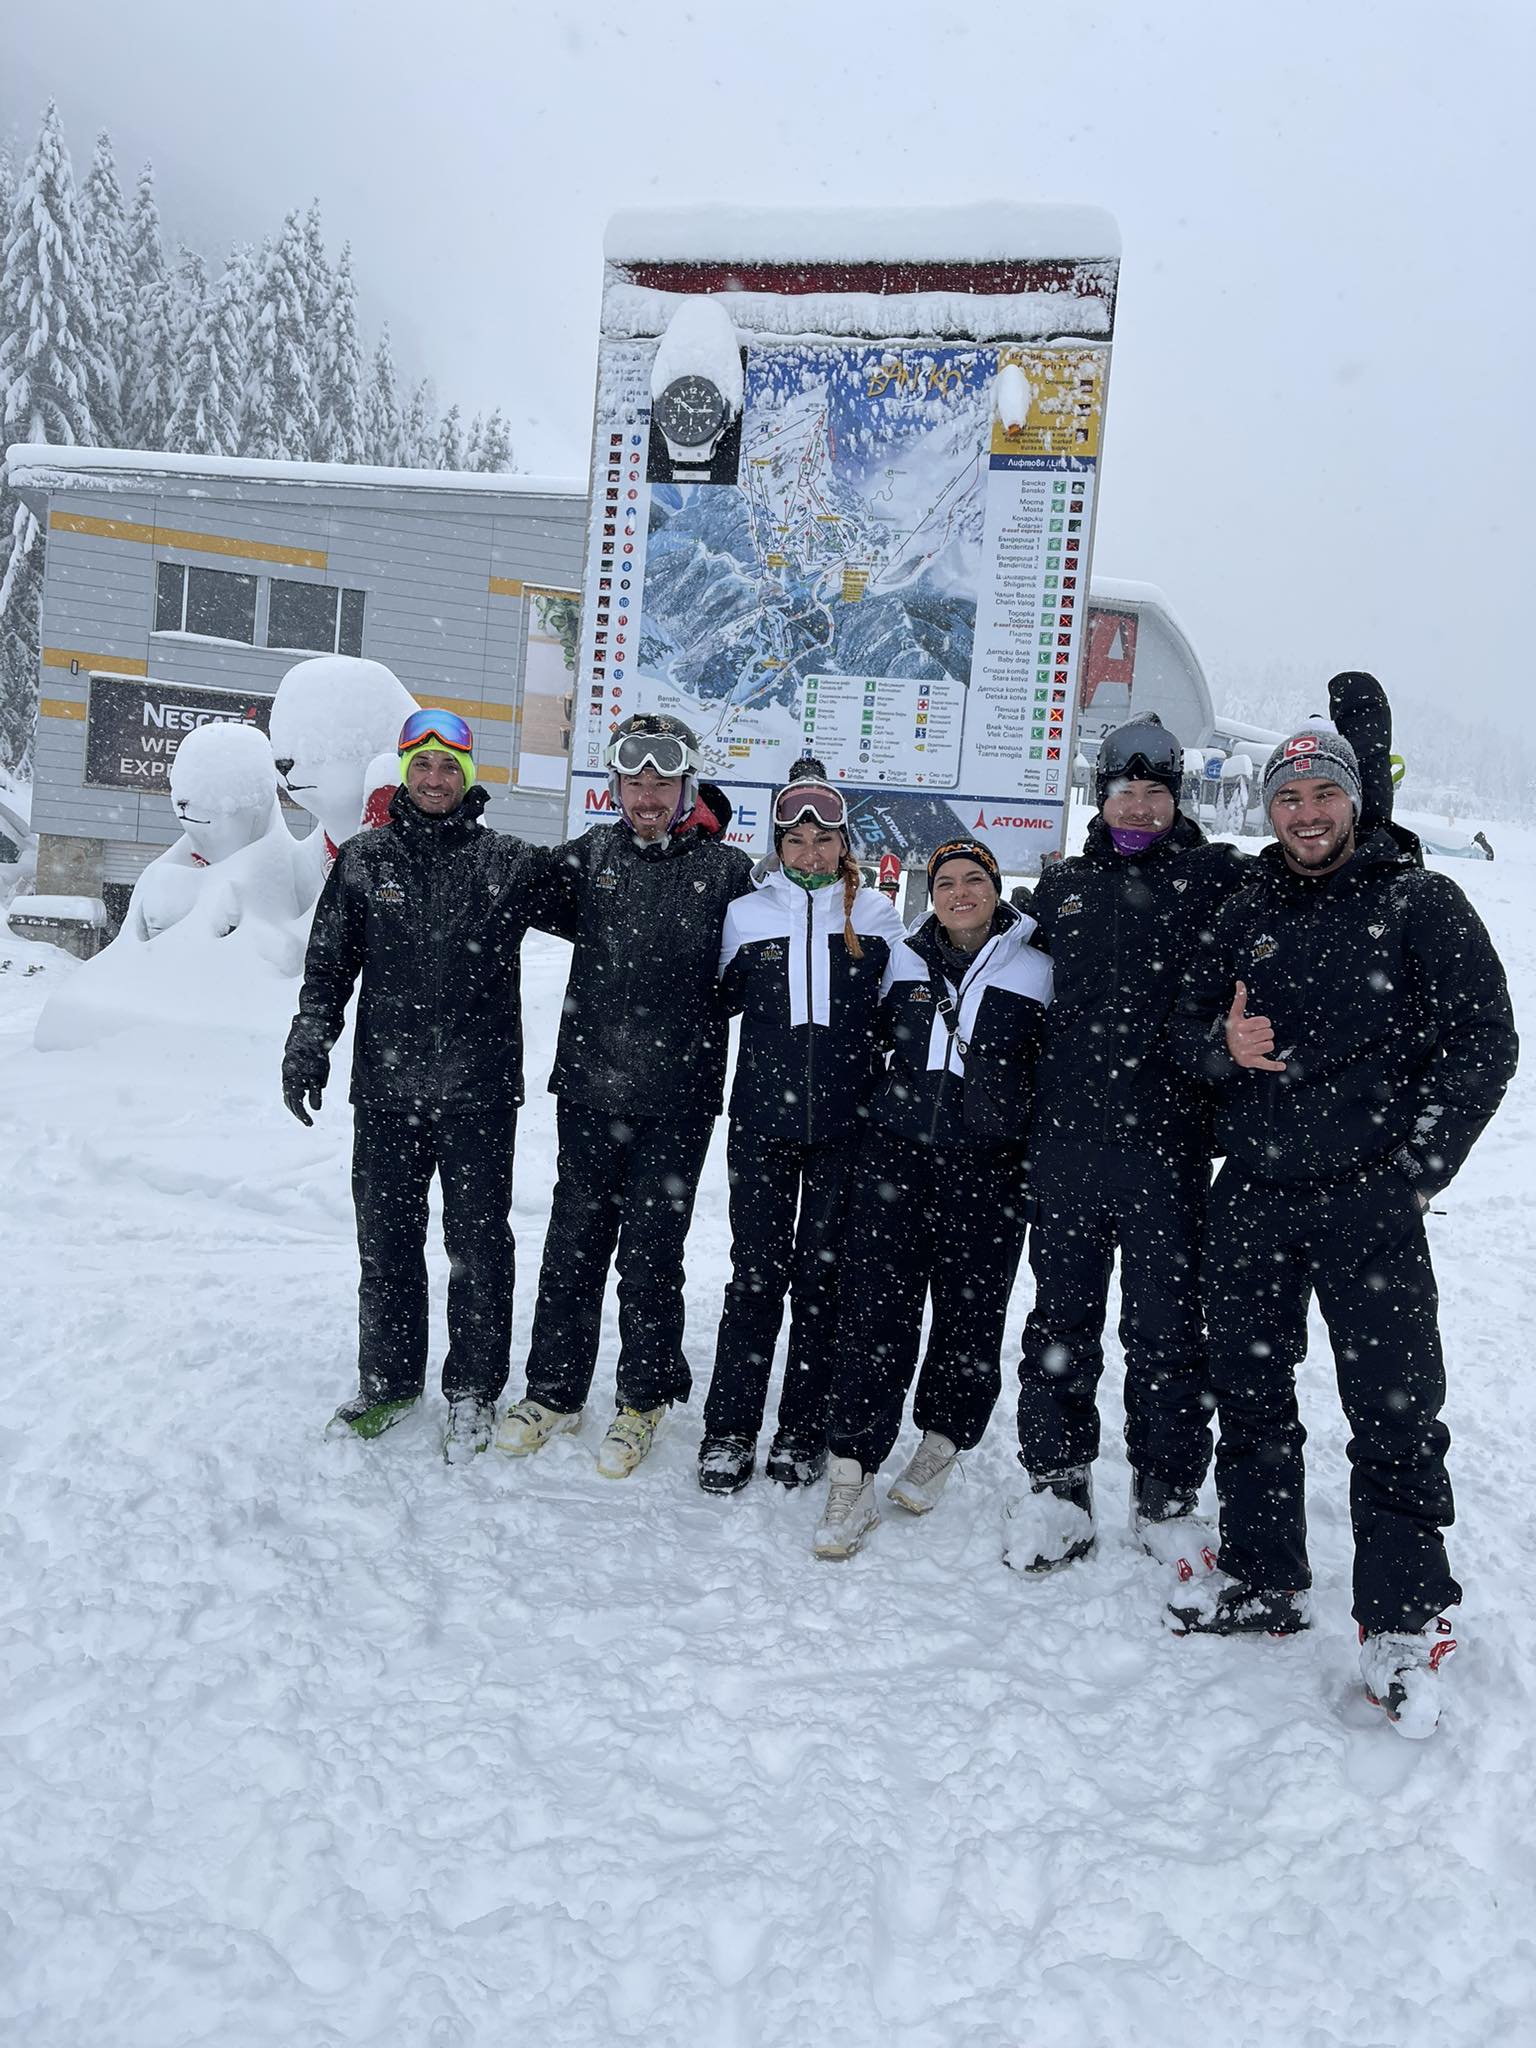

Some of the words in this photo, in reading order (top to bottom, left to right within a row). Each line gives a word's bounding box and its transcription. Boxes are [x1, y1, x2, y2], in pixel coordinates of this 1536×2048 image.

[143, 701, 256, 731] NESC
[856, 813, 886, 842] 175
[882, 813, 909, 848] ATOMIC
[991, 815, 1054, 830] ATOMIC
